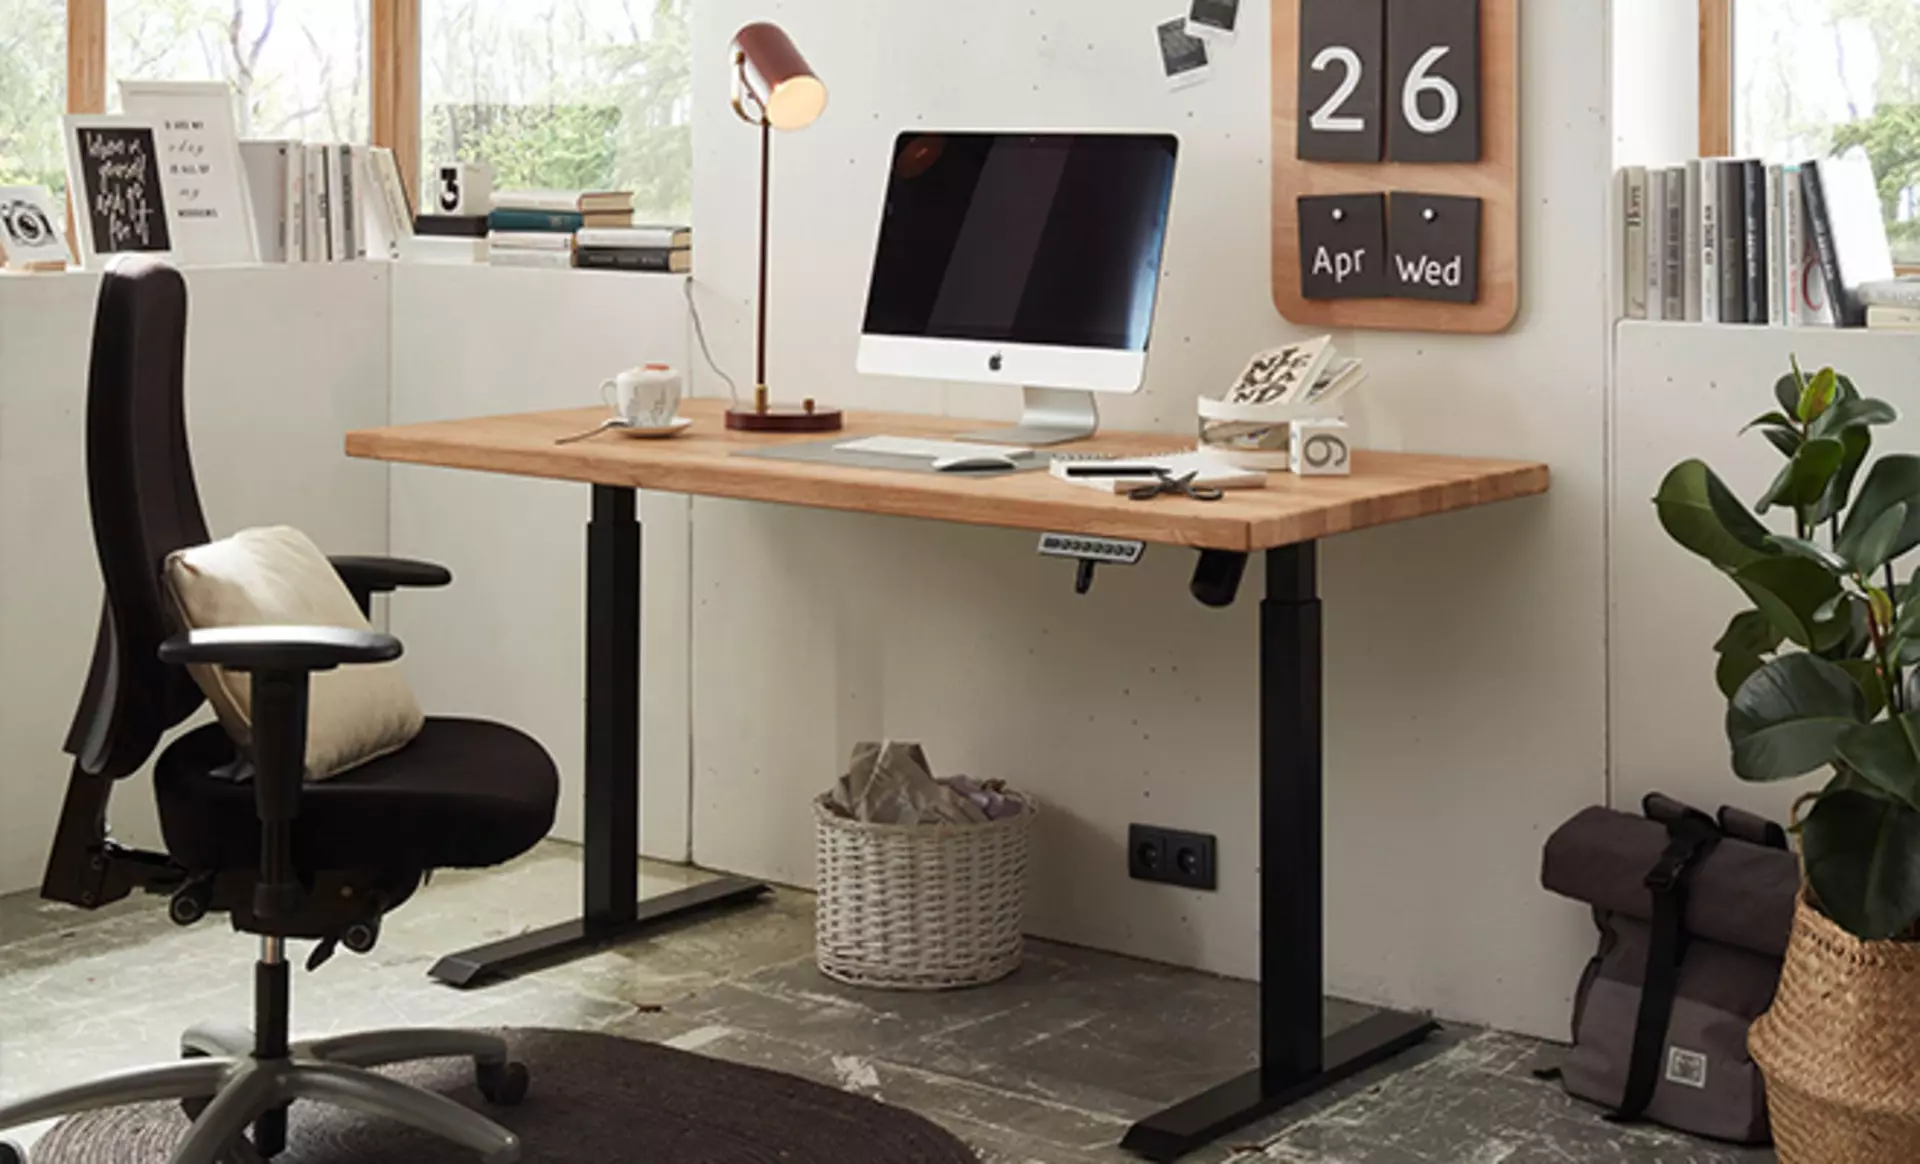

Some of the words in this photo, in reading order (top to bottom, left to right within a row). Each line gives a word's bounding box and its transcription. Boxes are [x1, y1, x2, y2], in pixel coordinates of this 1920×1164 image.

[441, 167, 460, 211] 3
[1312, 245, 1365, 283] Apr
[1395, 255, 1461, 286] Wed
